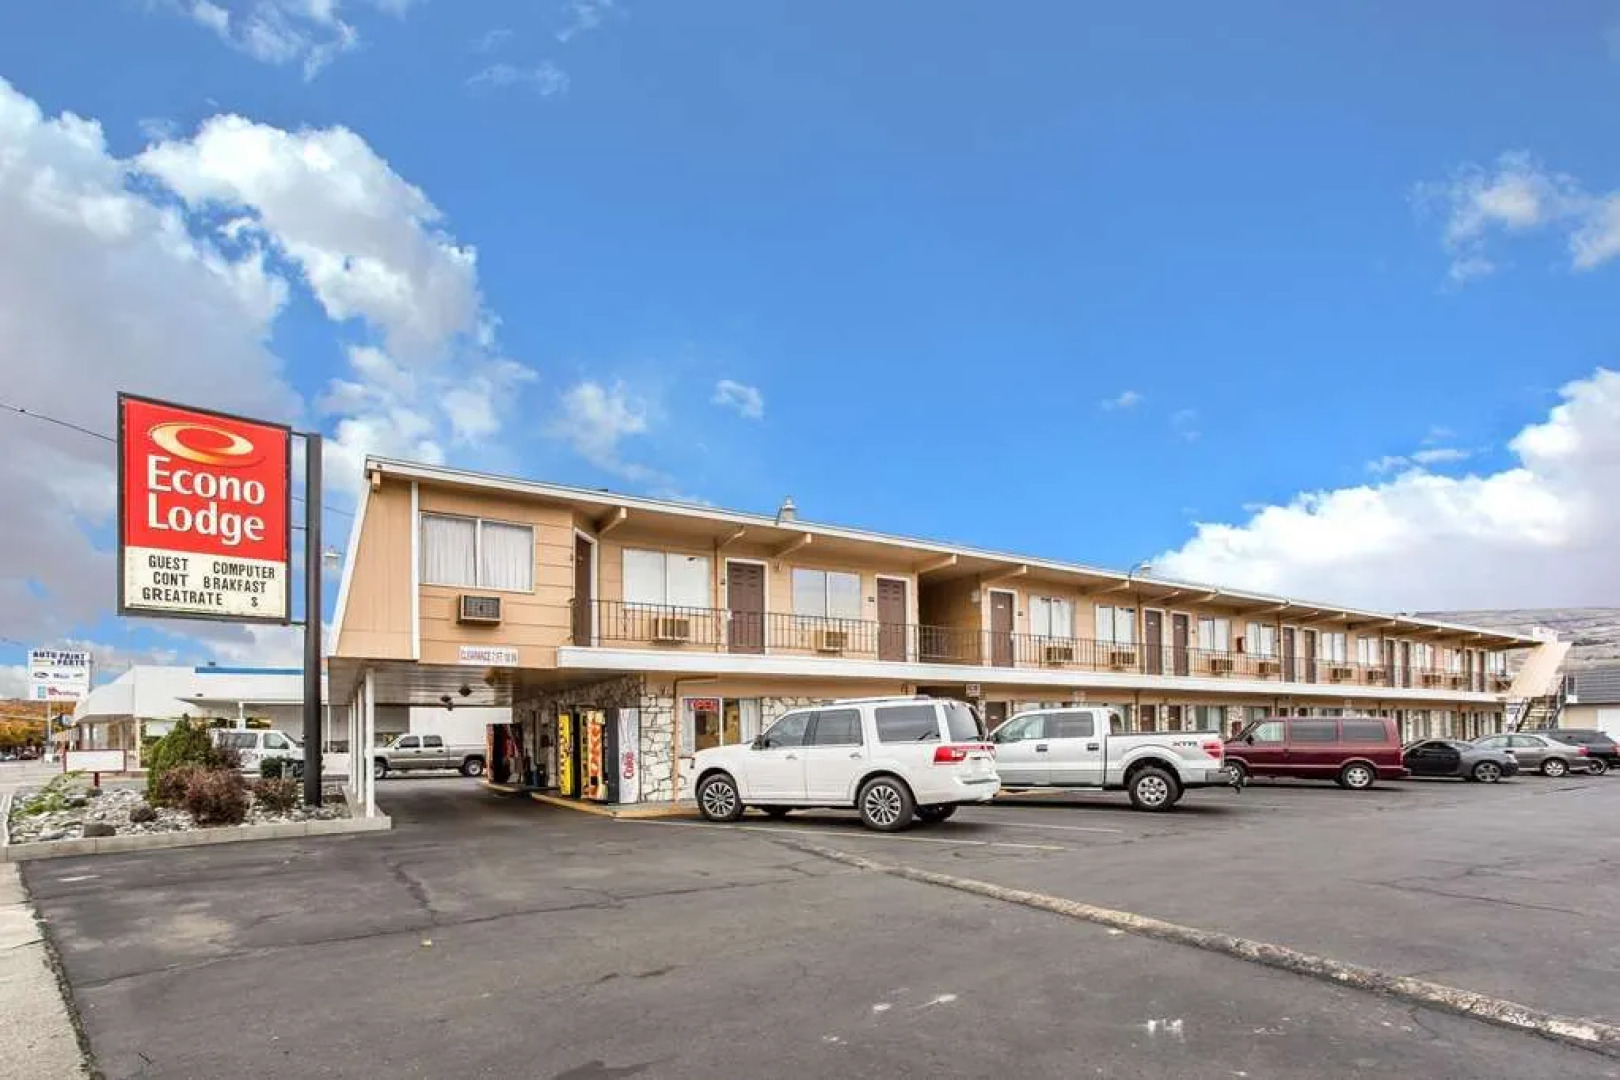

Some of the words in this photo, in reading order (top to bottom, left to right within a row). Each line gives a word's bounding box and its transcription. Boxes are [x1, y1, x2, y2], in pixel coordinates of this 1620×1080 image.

[147, 455, 265, 505] Econo
[148, 493, 265, 546] Lodge
[148, 554, 189, 571] GUEST
[213, 561, 275, 579] COMPUTER
[153, 571, 189, 587] CONT
[142, 586, 223, 606] GREATRATE
